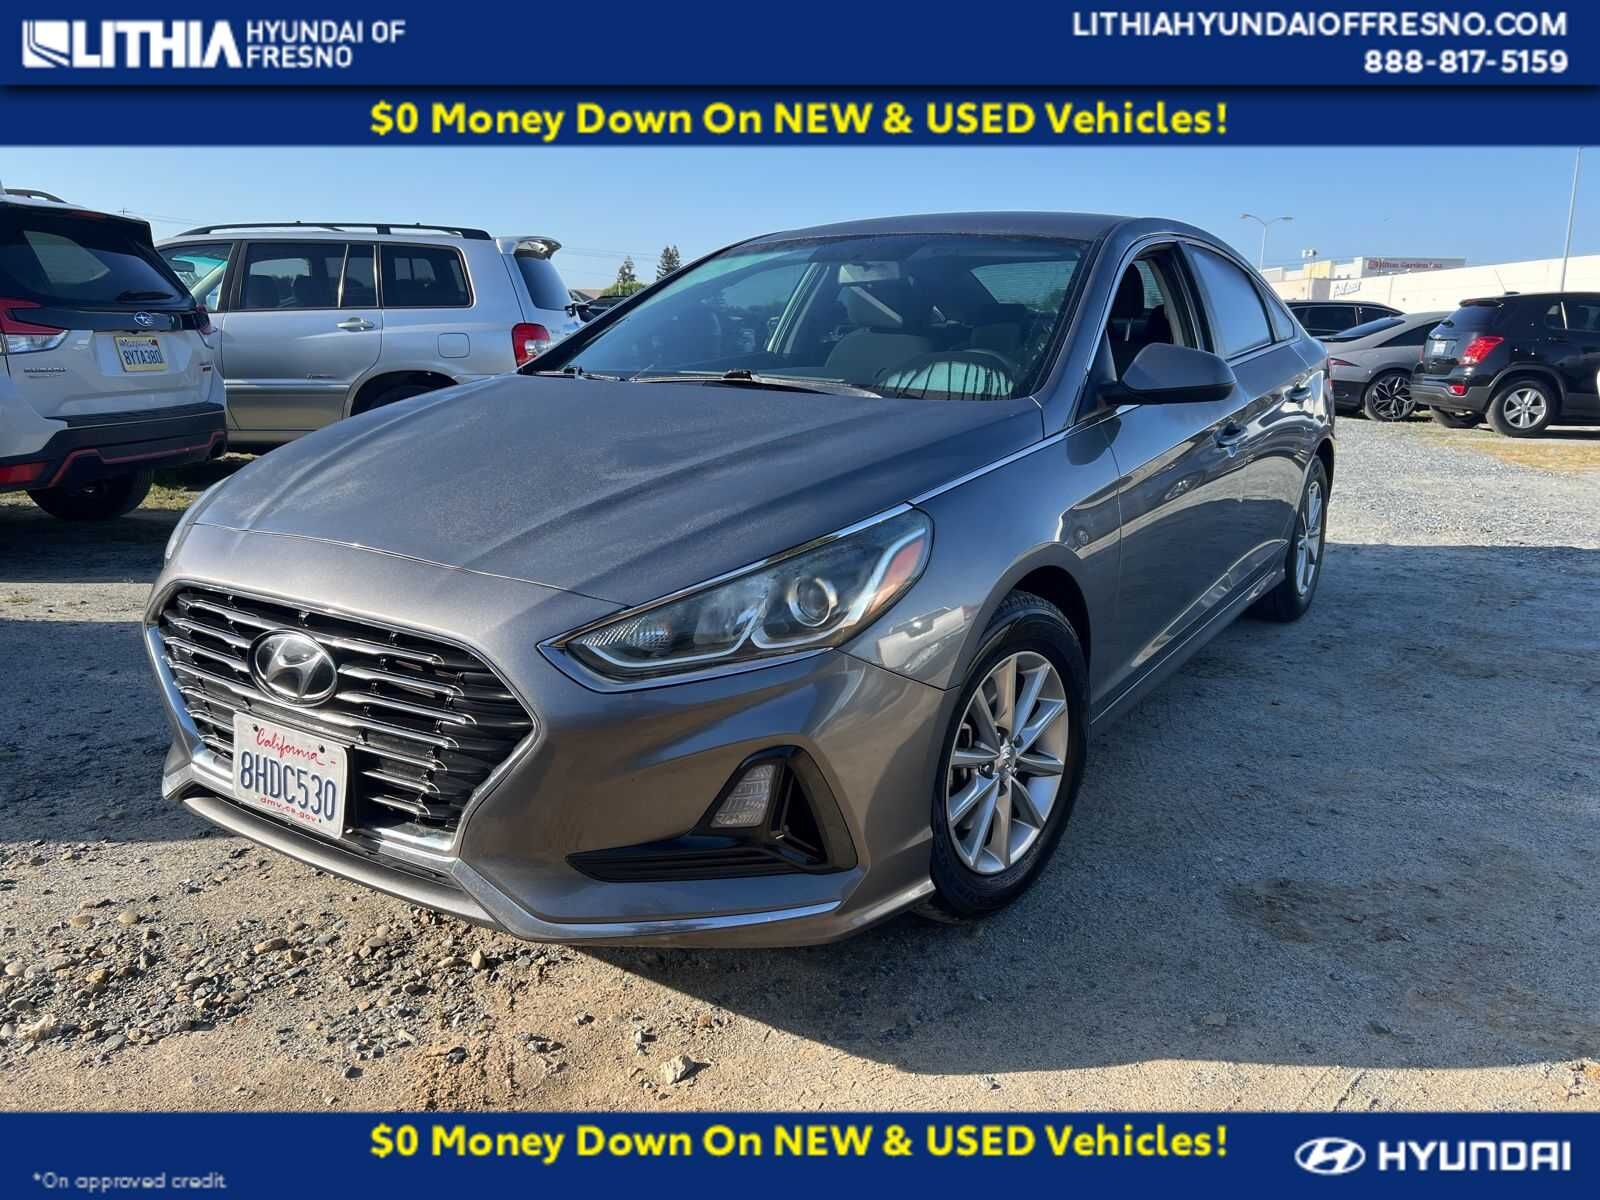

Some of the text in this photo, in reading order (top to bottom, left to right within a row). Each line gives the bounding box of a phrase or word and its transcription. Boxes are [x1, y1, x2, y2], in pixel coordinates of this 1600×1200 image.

[256, 727, 325, 766] California
[240, 751, 336, 821] 8HDC530
[259, 797, 317, 822] dmv.ca.gov
